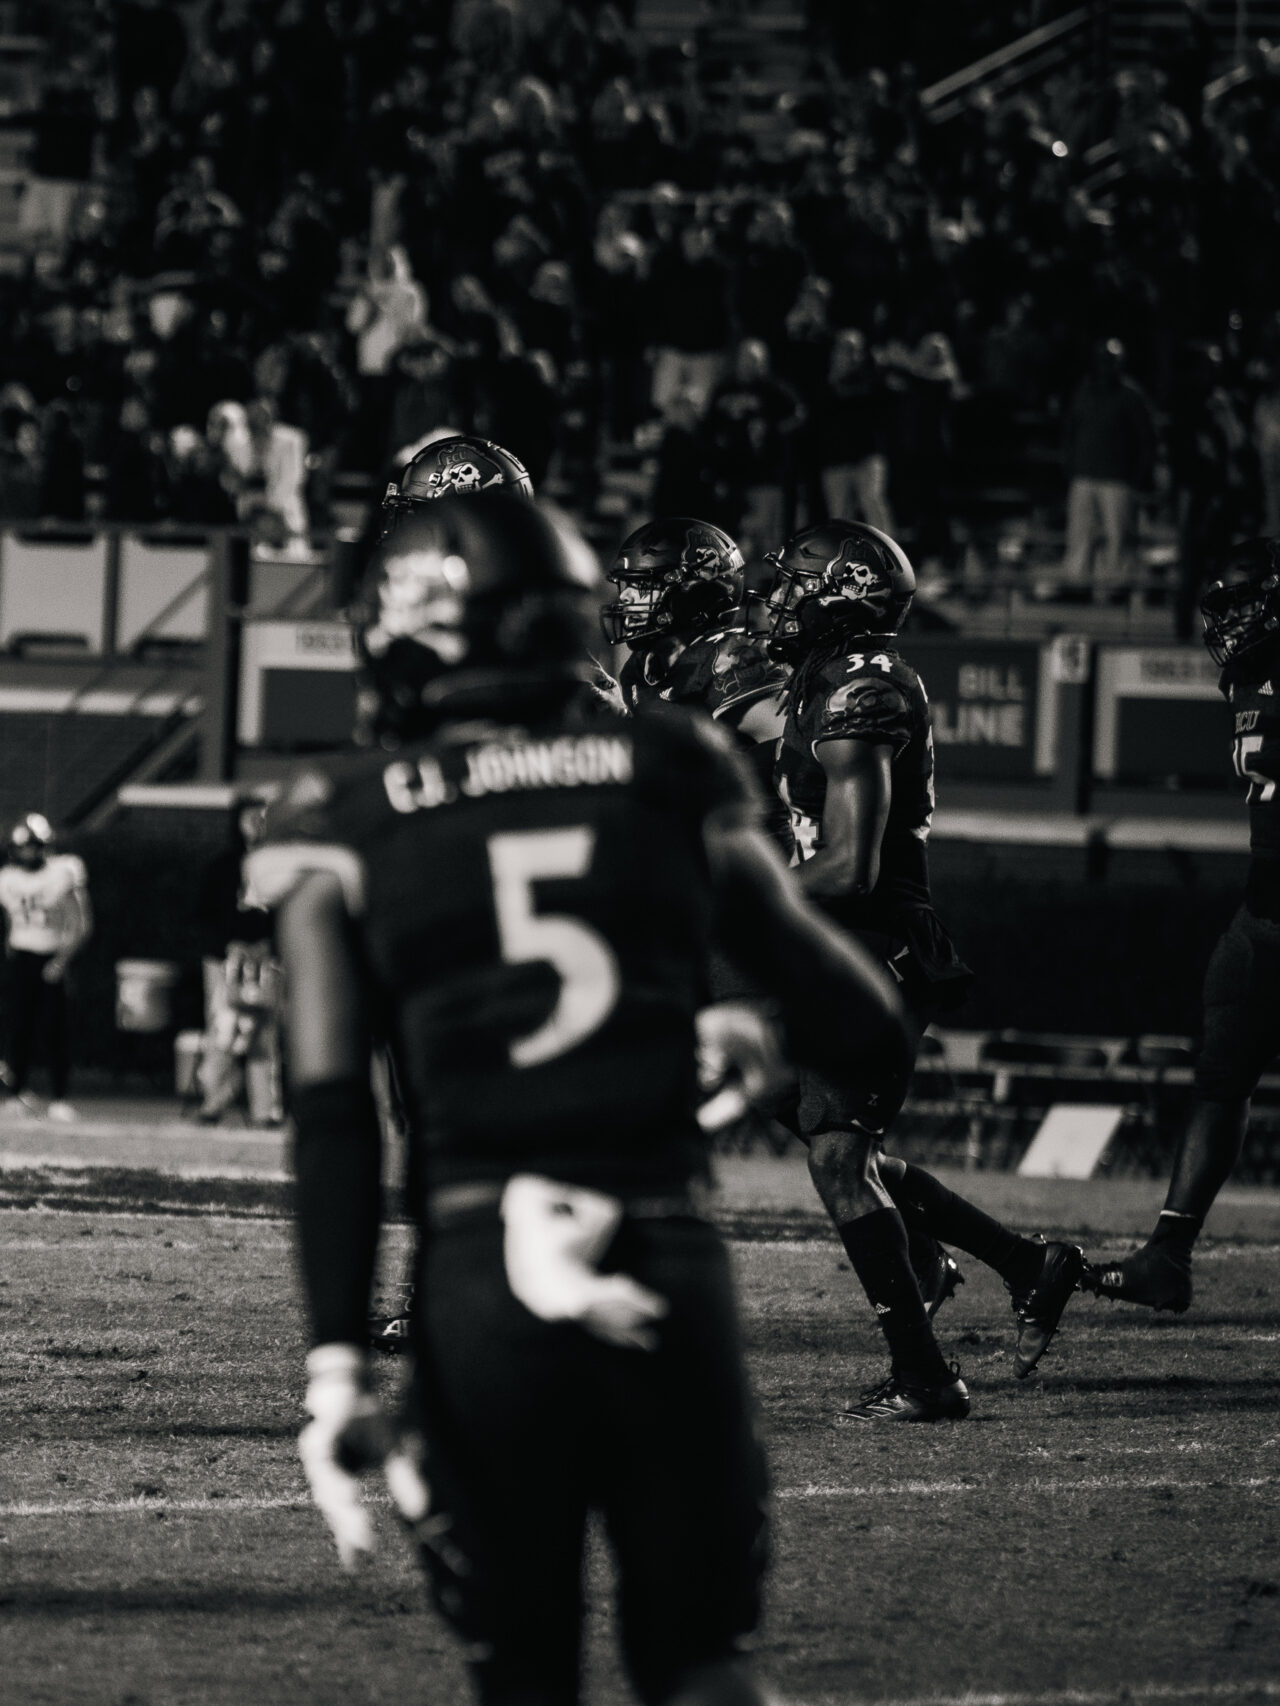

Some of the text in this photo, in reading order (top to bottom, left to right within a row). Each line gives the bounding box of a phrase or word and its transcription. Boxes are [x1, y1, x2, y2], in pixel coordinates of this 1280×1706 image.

[846, 653, 894, 673] 34
[958, 663, 1024, 700] BILL
[461, 735, 634, 798] JOHNSON
[486, 822, 622, 1070] 5
